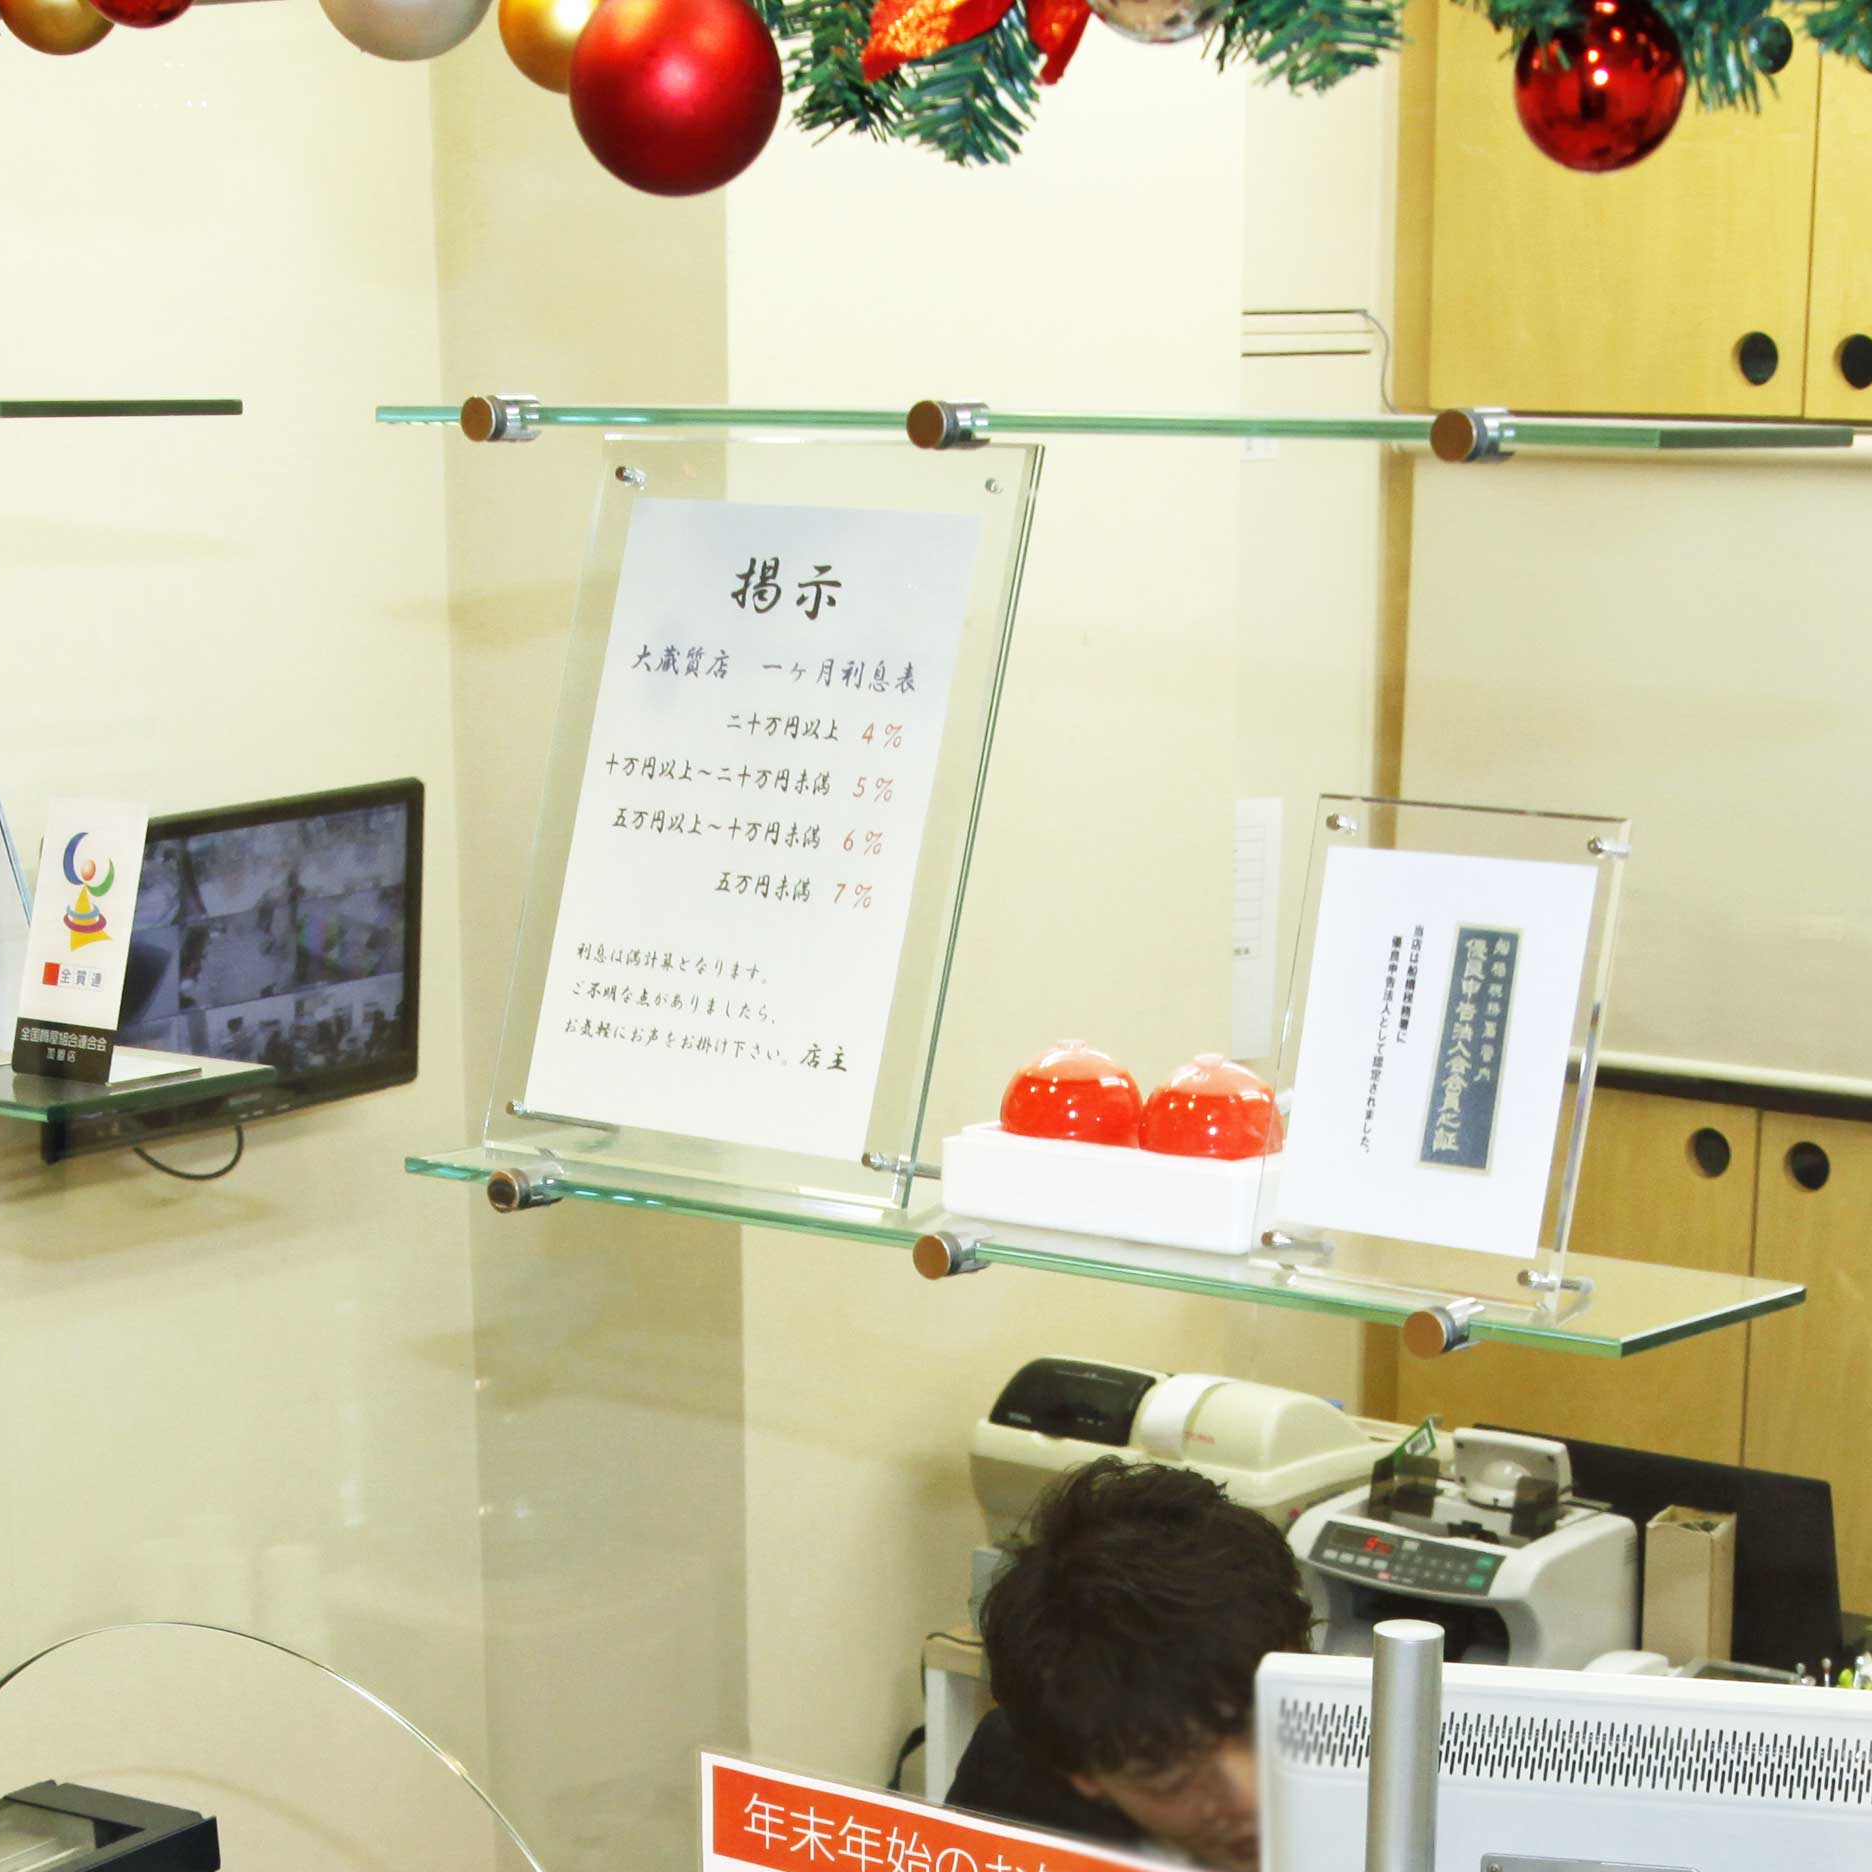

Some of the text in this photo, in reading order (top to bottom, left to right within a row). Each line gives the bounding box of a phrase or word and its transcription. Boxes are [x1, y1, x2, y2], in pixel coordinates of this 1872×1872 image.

[731, 557, 843, 620] 掲示
[632, 643, 730, 680] 大蔵質店
[726, 712, 839, 742] 二十万円以上
[715, 871, 811, 902] 五万円未満
[800, 1043, 849, 1072] 店主
